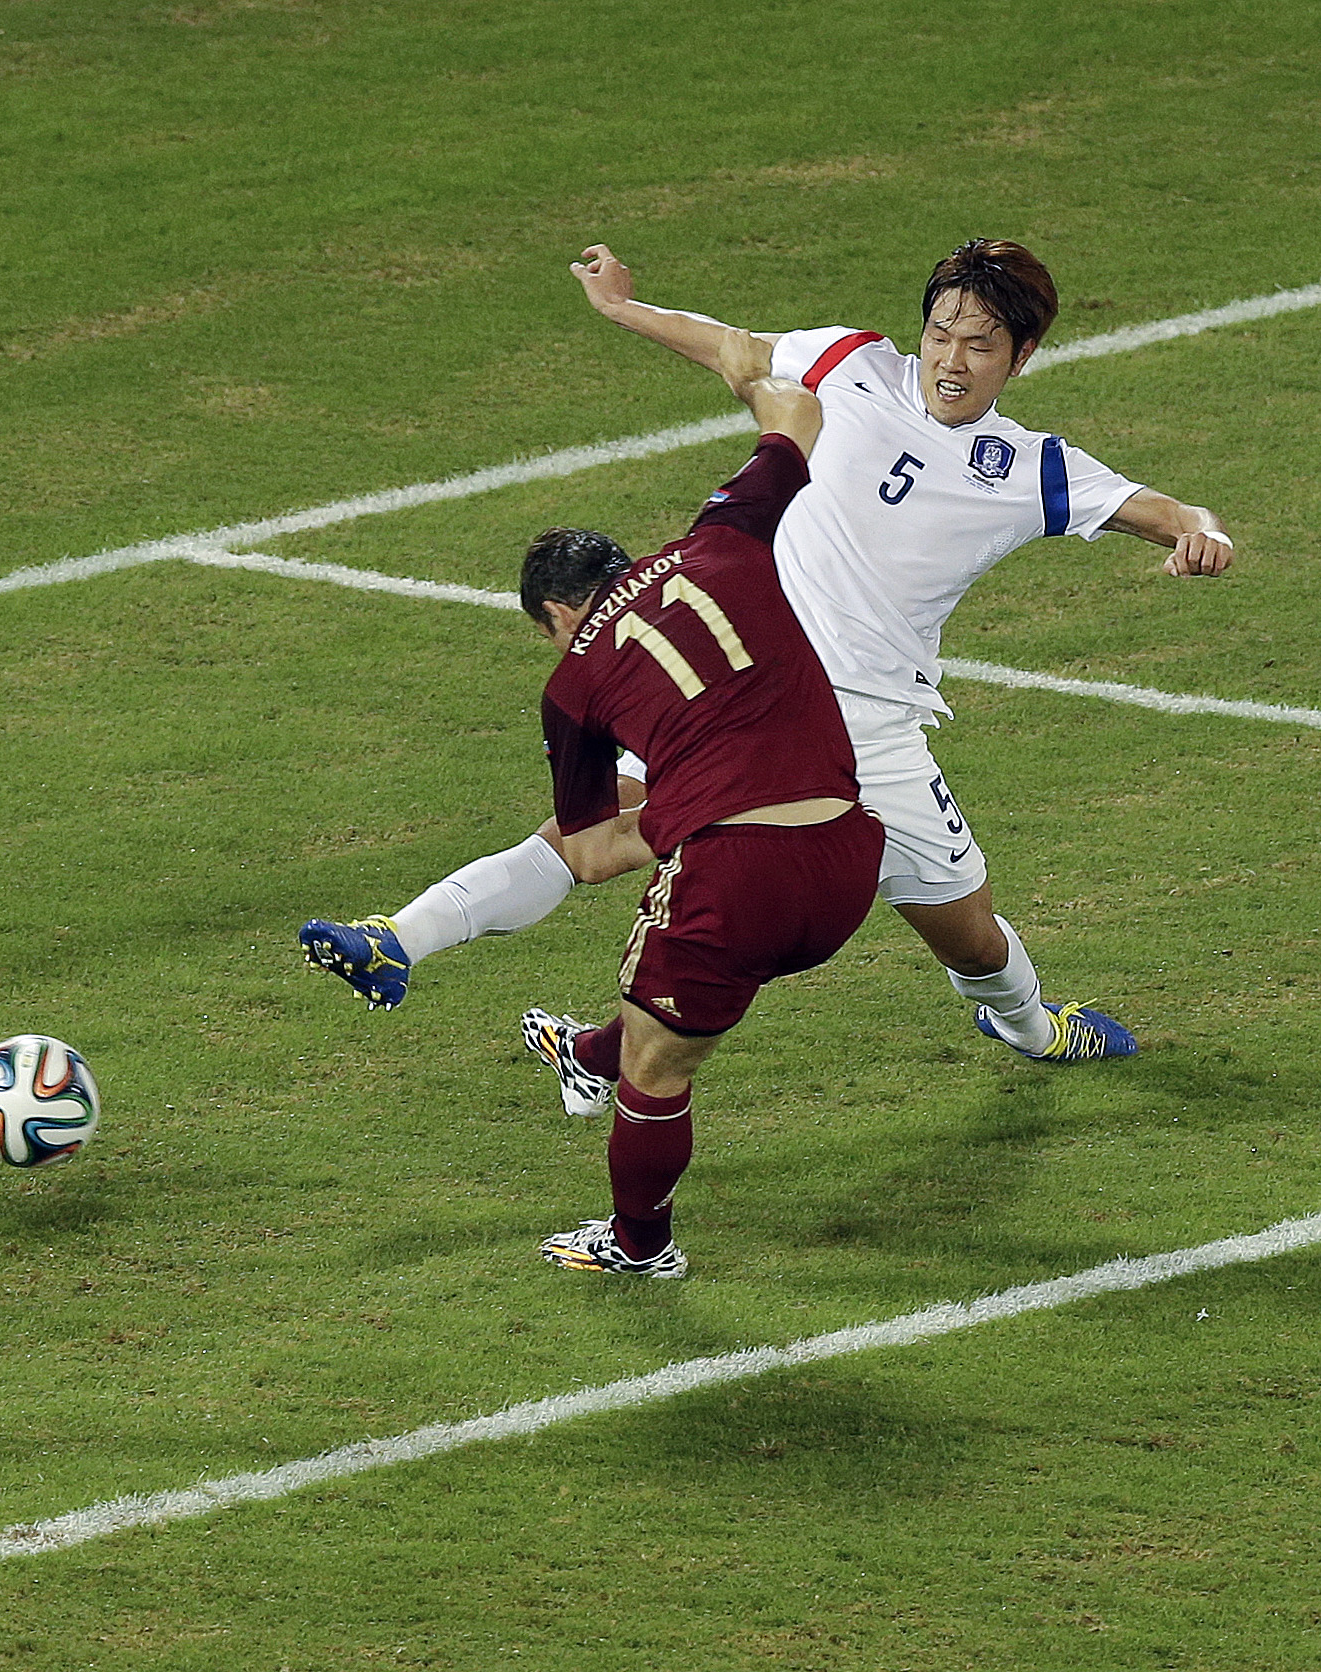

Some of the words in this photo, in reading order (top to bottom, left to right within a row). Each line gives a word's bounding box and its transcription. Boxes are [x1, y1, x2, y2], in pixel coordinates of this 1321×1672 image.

[879, 451, 925, 505] 5
[570, 549, 684, 656] KERZHAKOV
[614, 573, 754, 700] 11
[929, 774, 963, 834] 5
